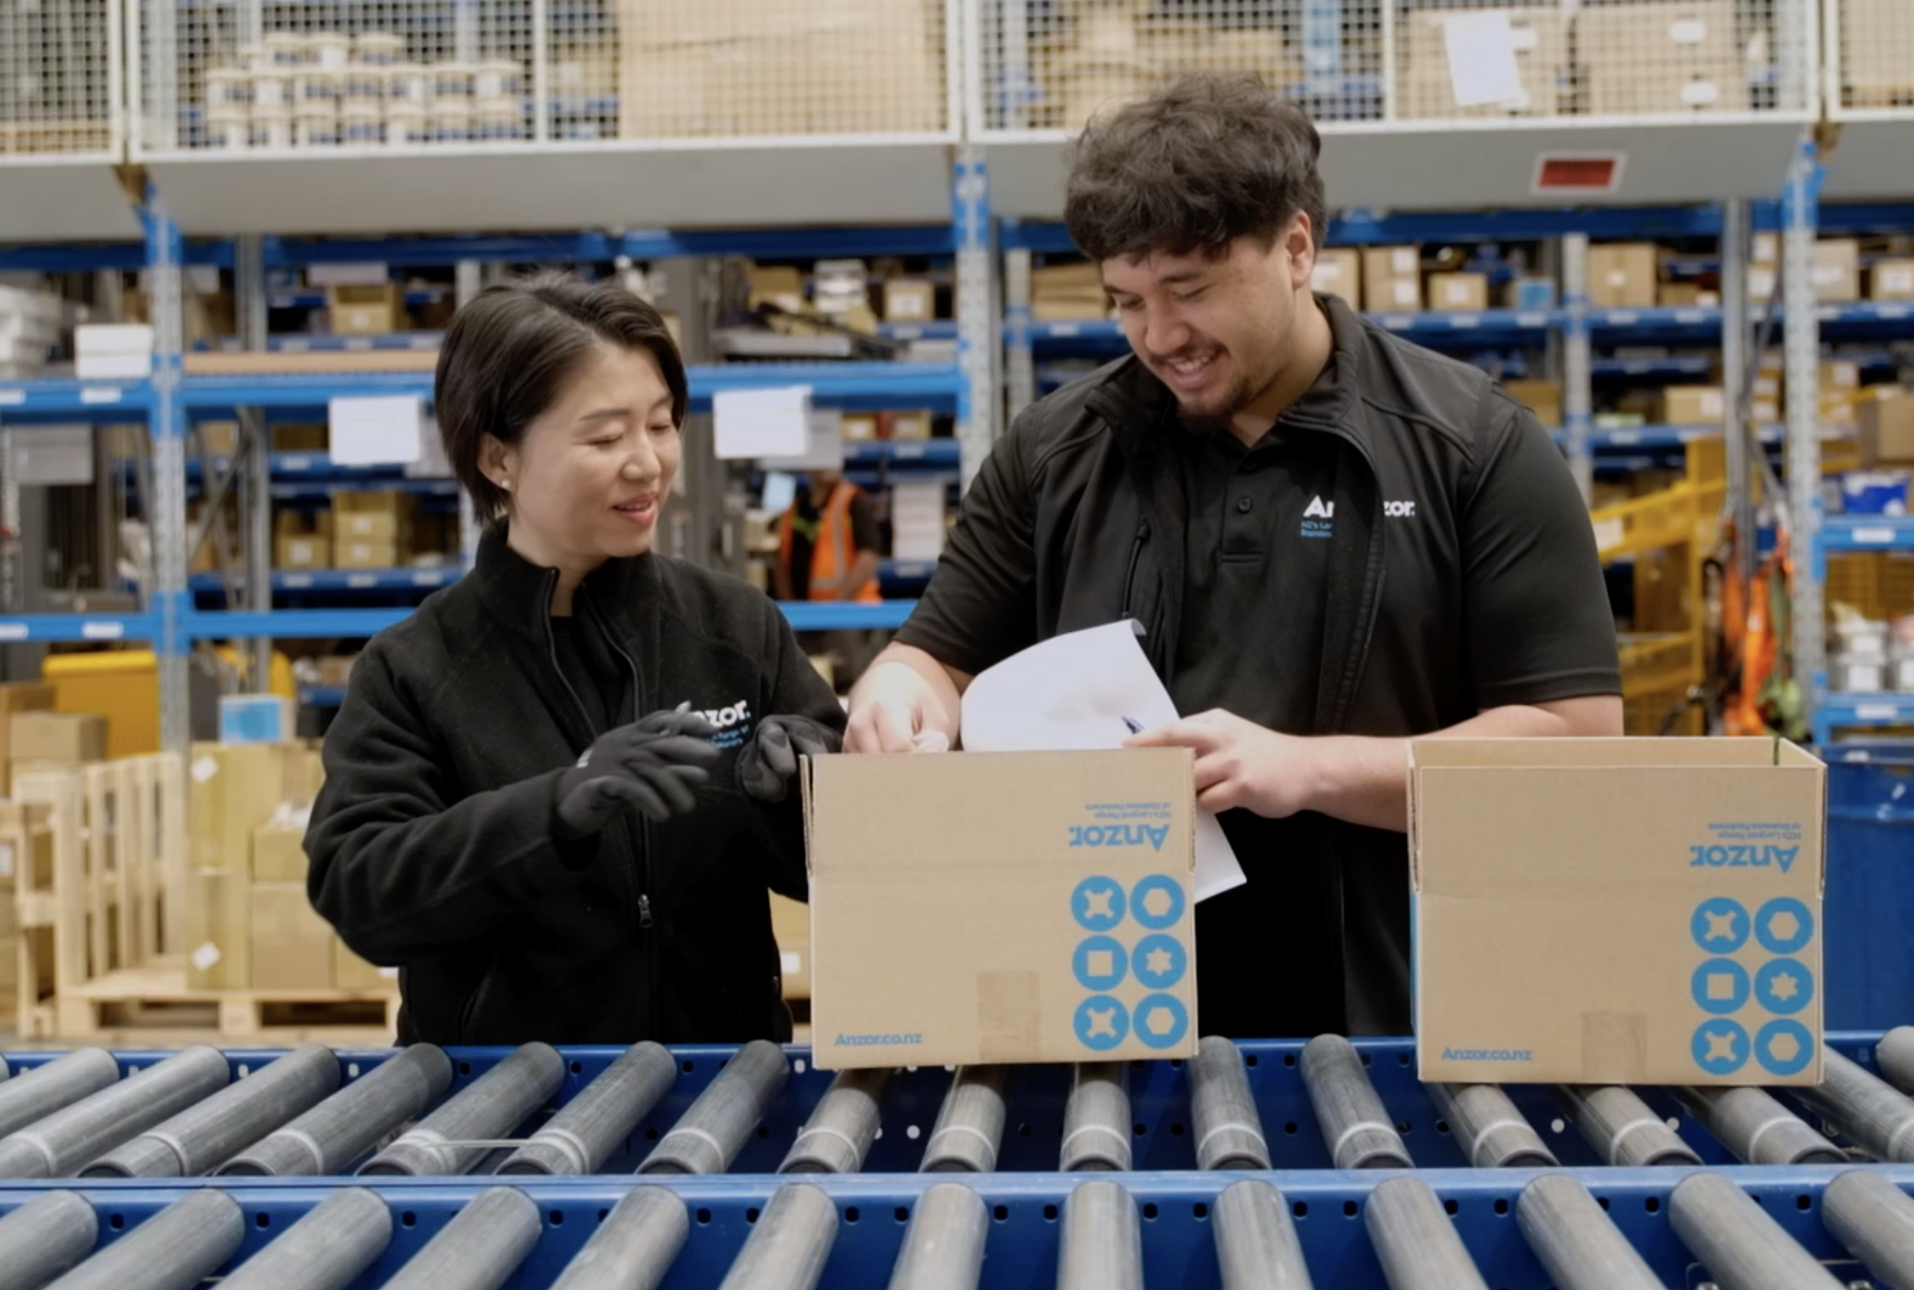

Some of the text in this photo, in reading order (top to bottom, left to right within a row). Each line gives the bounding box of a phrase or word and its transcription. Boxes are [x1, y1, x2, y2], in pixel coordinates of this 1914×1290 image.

[1068, 824, 1170, 852] Anzor.
[1690, 844, 1801, 873] Anzor.
[834, 1033, 922, 1047] Anzor.co.nz
[1441, 1047, 1532, 1061] Anzor.co.nz
